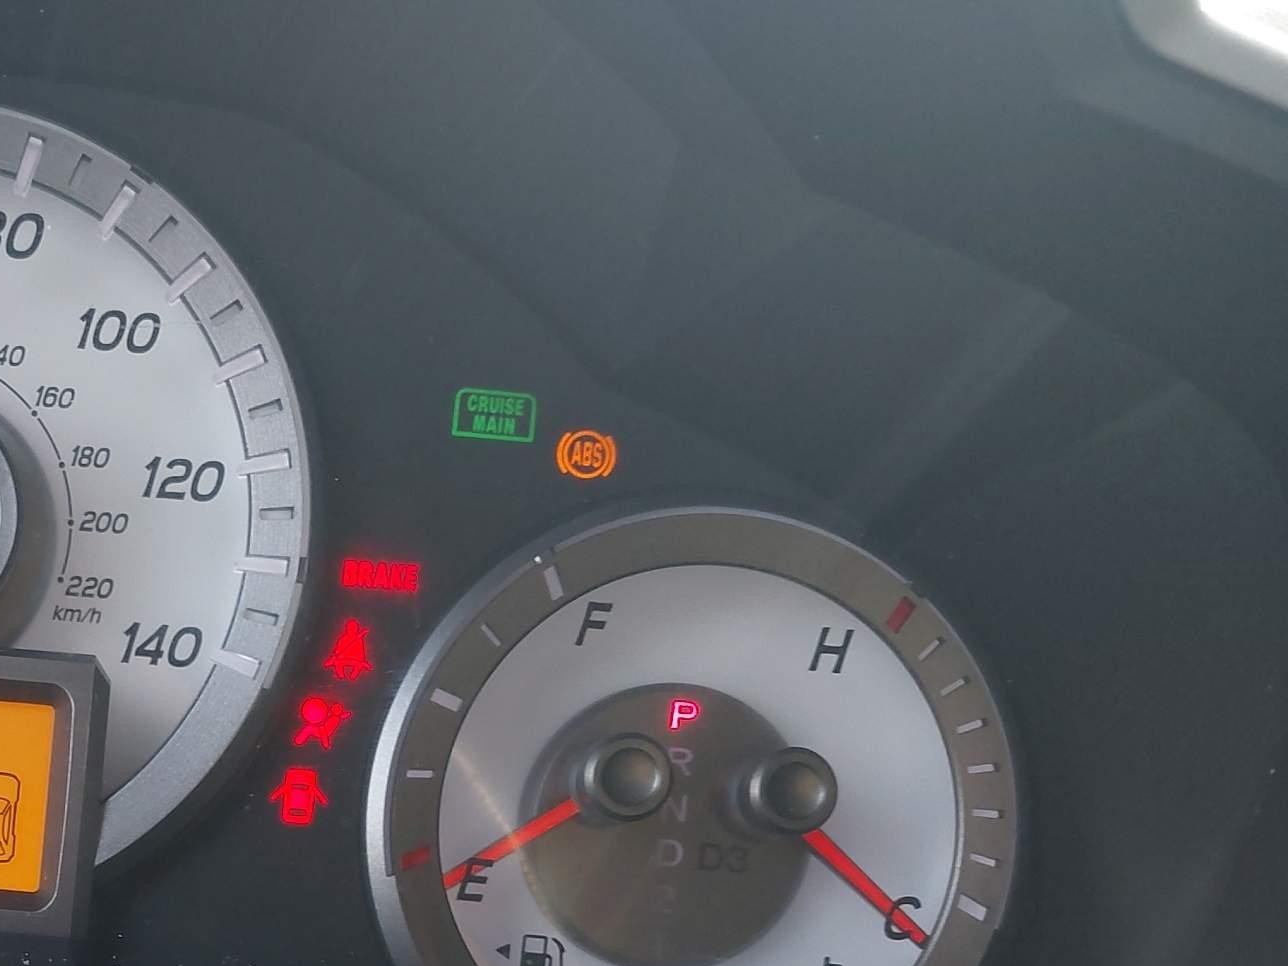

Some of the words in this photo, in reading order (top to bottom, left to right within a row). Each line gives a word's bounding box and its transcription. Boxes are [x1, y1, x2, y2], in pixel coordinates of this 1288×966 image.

[77, 308, 162, 354] 100
[35, 385, 75, 410] 160
[467, 395, 524, 415] CRUISE
[472, 415, 516, 434] MAIN
[70, 446, 110, 470] 180
[571, 441, 603, 468] ABS
[141, 458, 225, 502] 120
[79, 513, 129, 535] 200
[65, 576, 113, 600] 220
[342, 559, 419, 592] BRAKE
[51, 604, 102, 626] km/h
[573, 602, 612, 646] F
[119, 623, 203, 669] 140
[809, 627, 855, 674] H
[669, 700, 700, 730] P
[668, 747, 694, 777] R
[662, 795, 688, 823] N
[658, 840, 684, 867] D
[456, 857, 493, 903] E
[883, 896, 922, 941] C
